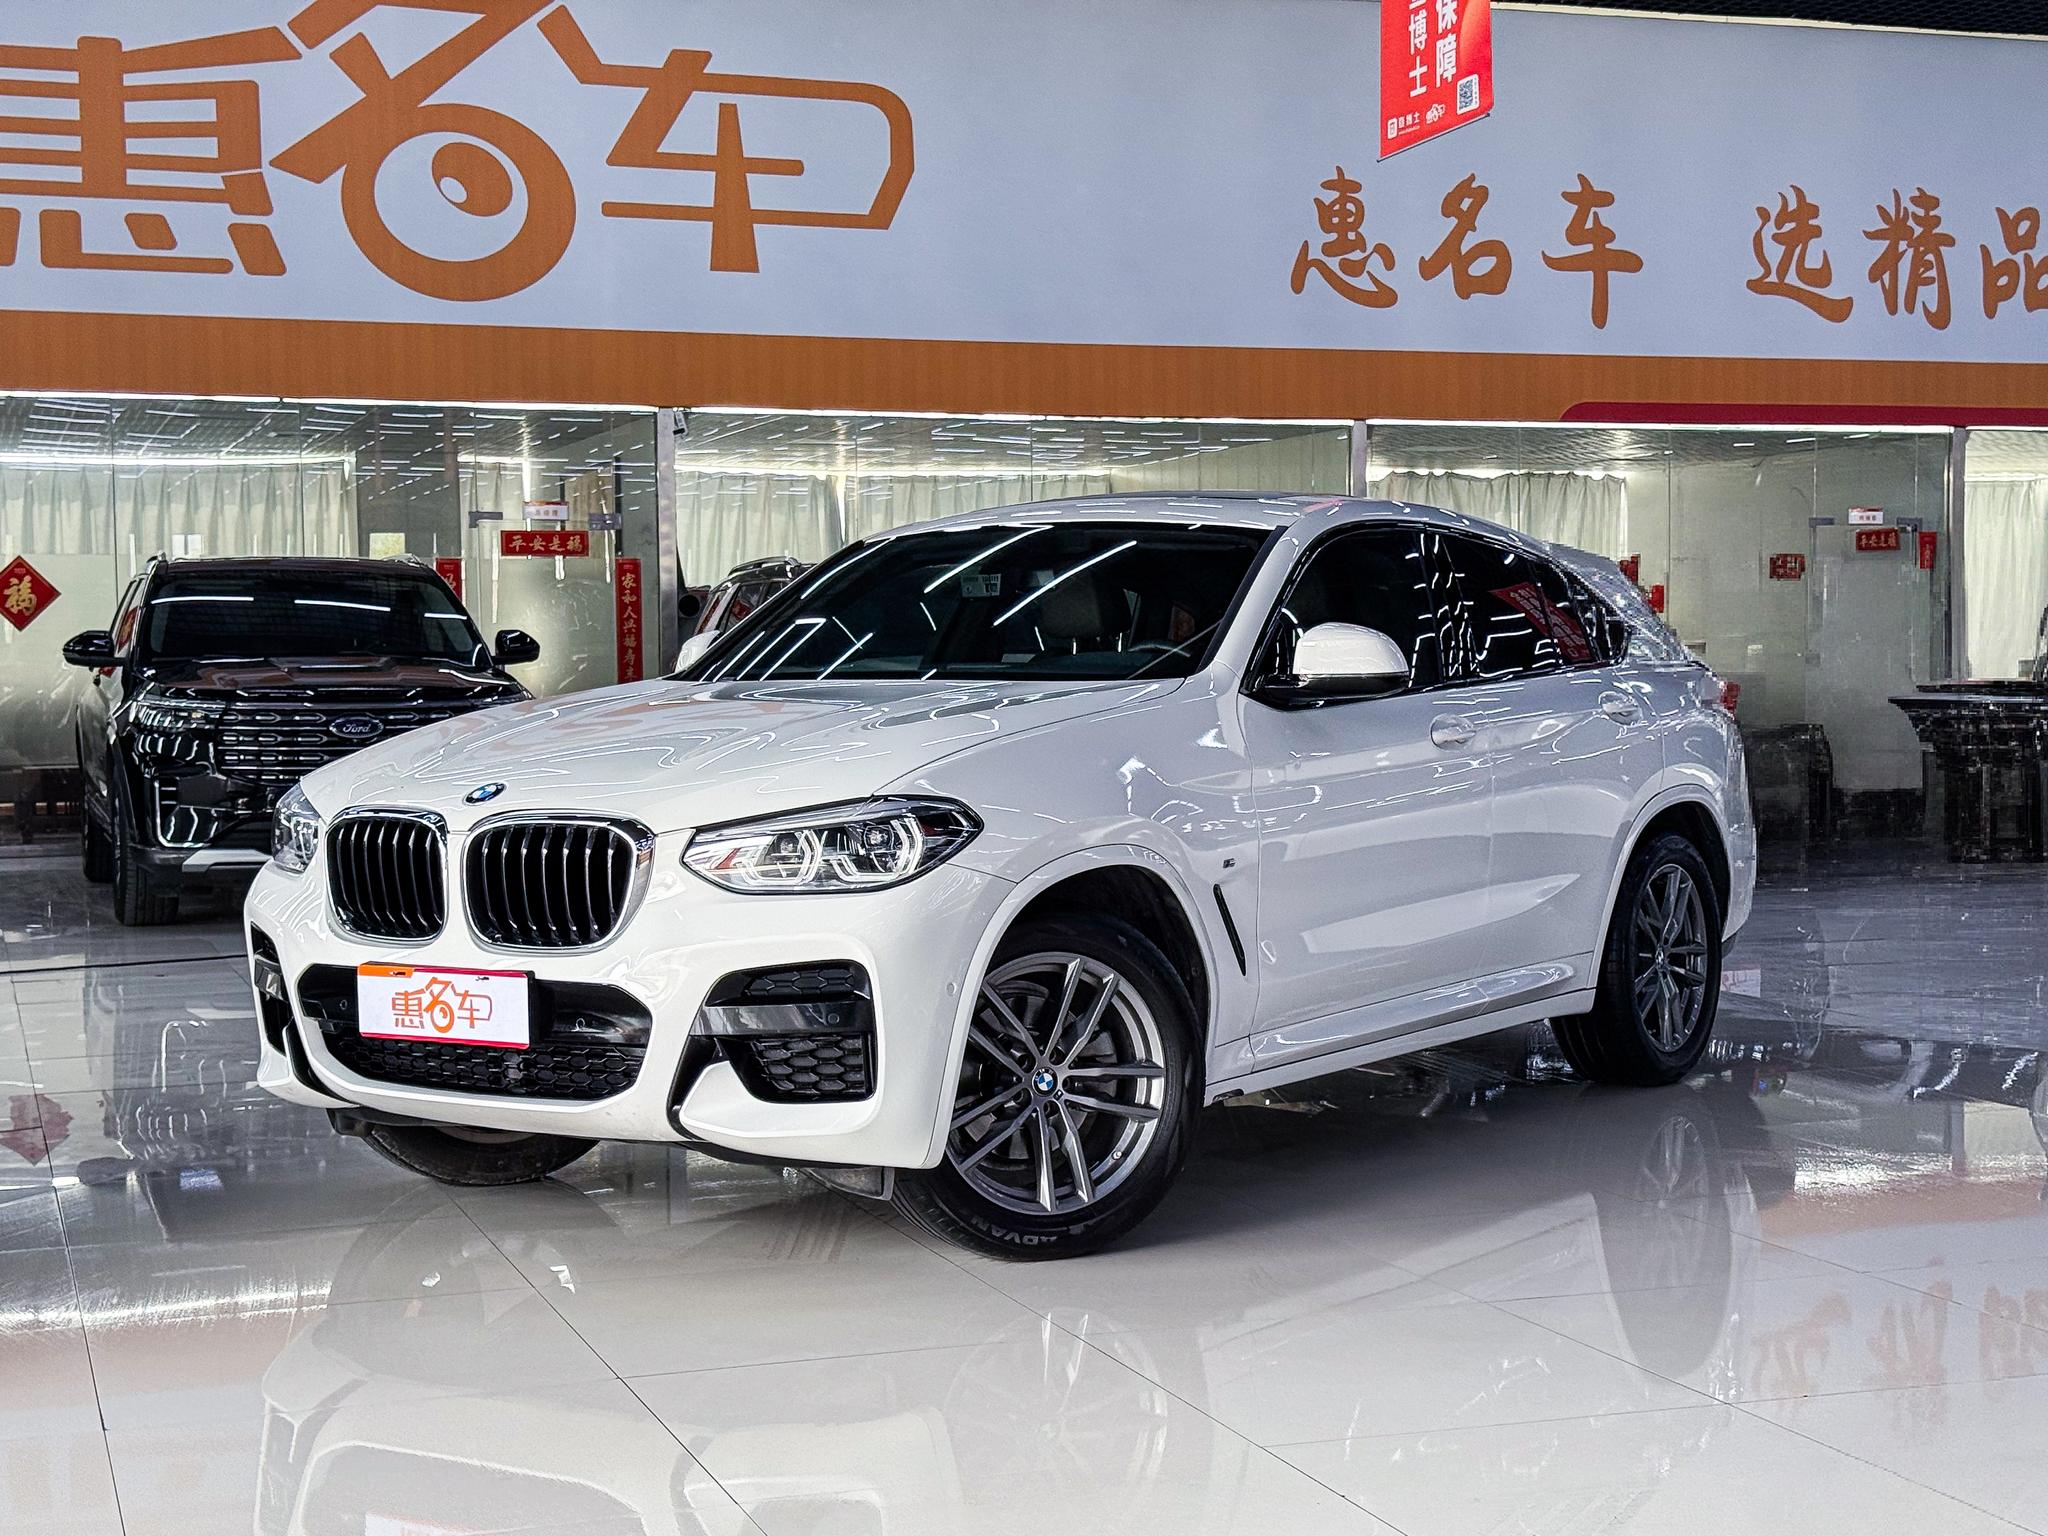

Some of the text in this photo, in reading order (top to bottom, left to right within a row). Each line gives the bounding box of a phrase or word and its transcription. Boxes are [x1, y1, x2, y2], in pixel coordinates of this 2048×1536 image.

[1408, 0, 1428, 98] 博士
[1289, 165, 1643, 329] 惠名车
[508, 534, 584, 554] 平安是福
[3, 575, 37, 616] 福
[341, 721, 368, 731] Ford
[391, 976, 493, 1033] 惠名车
